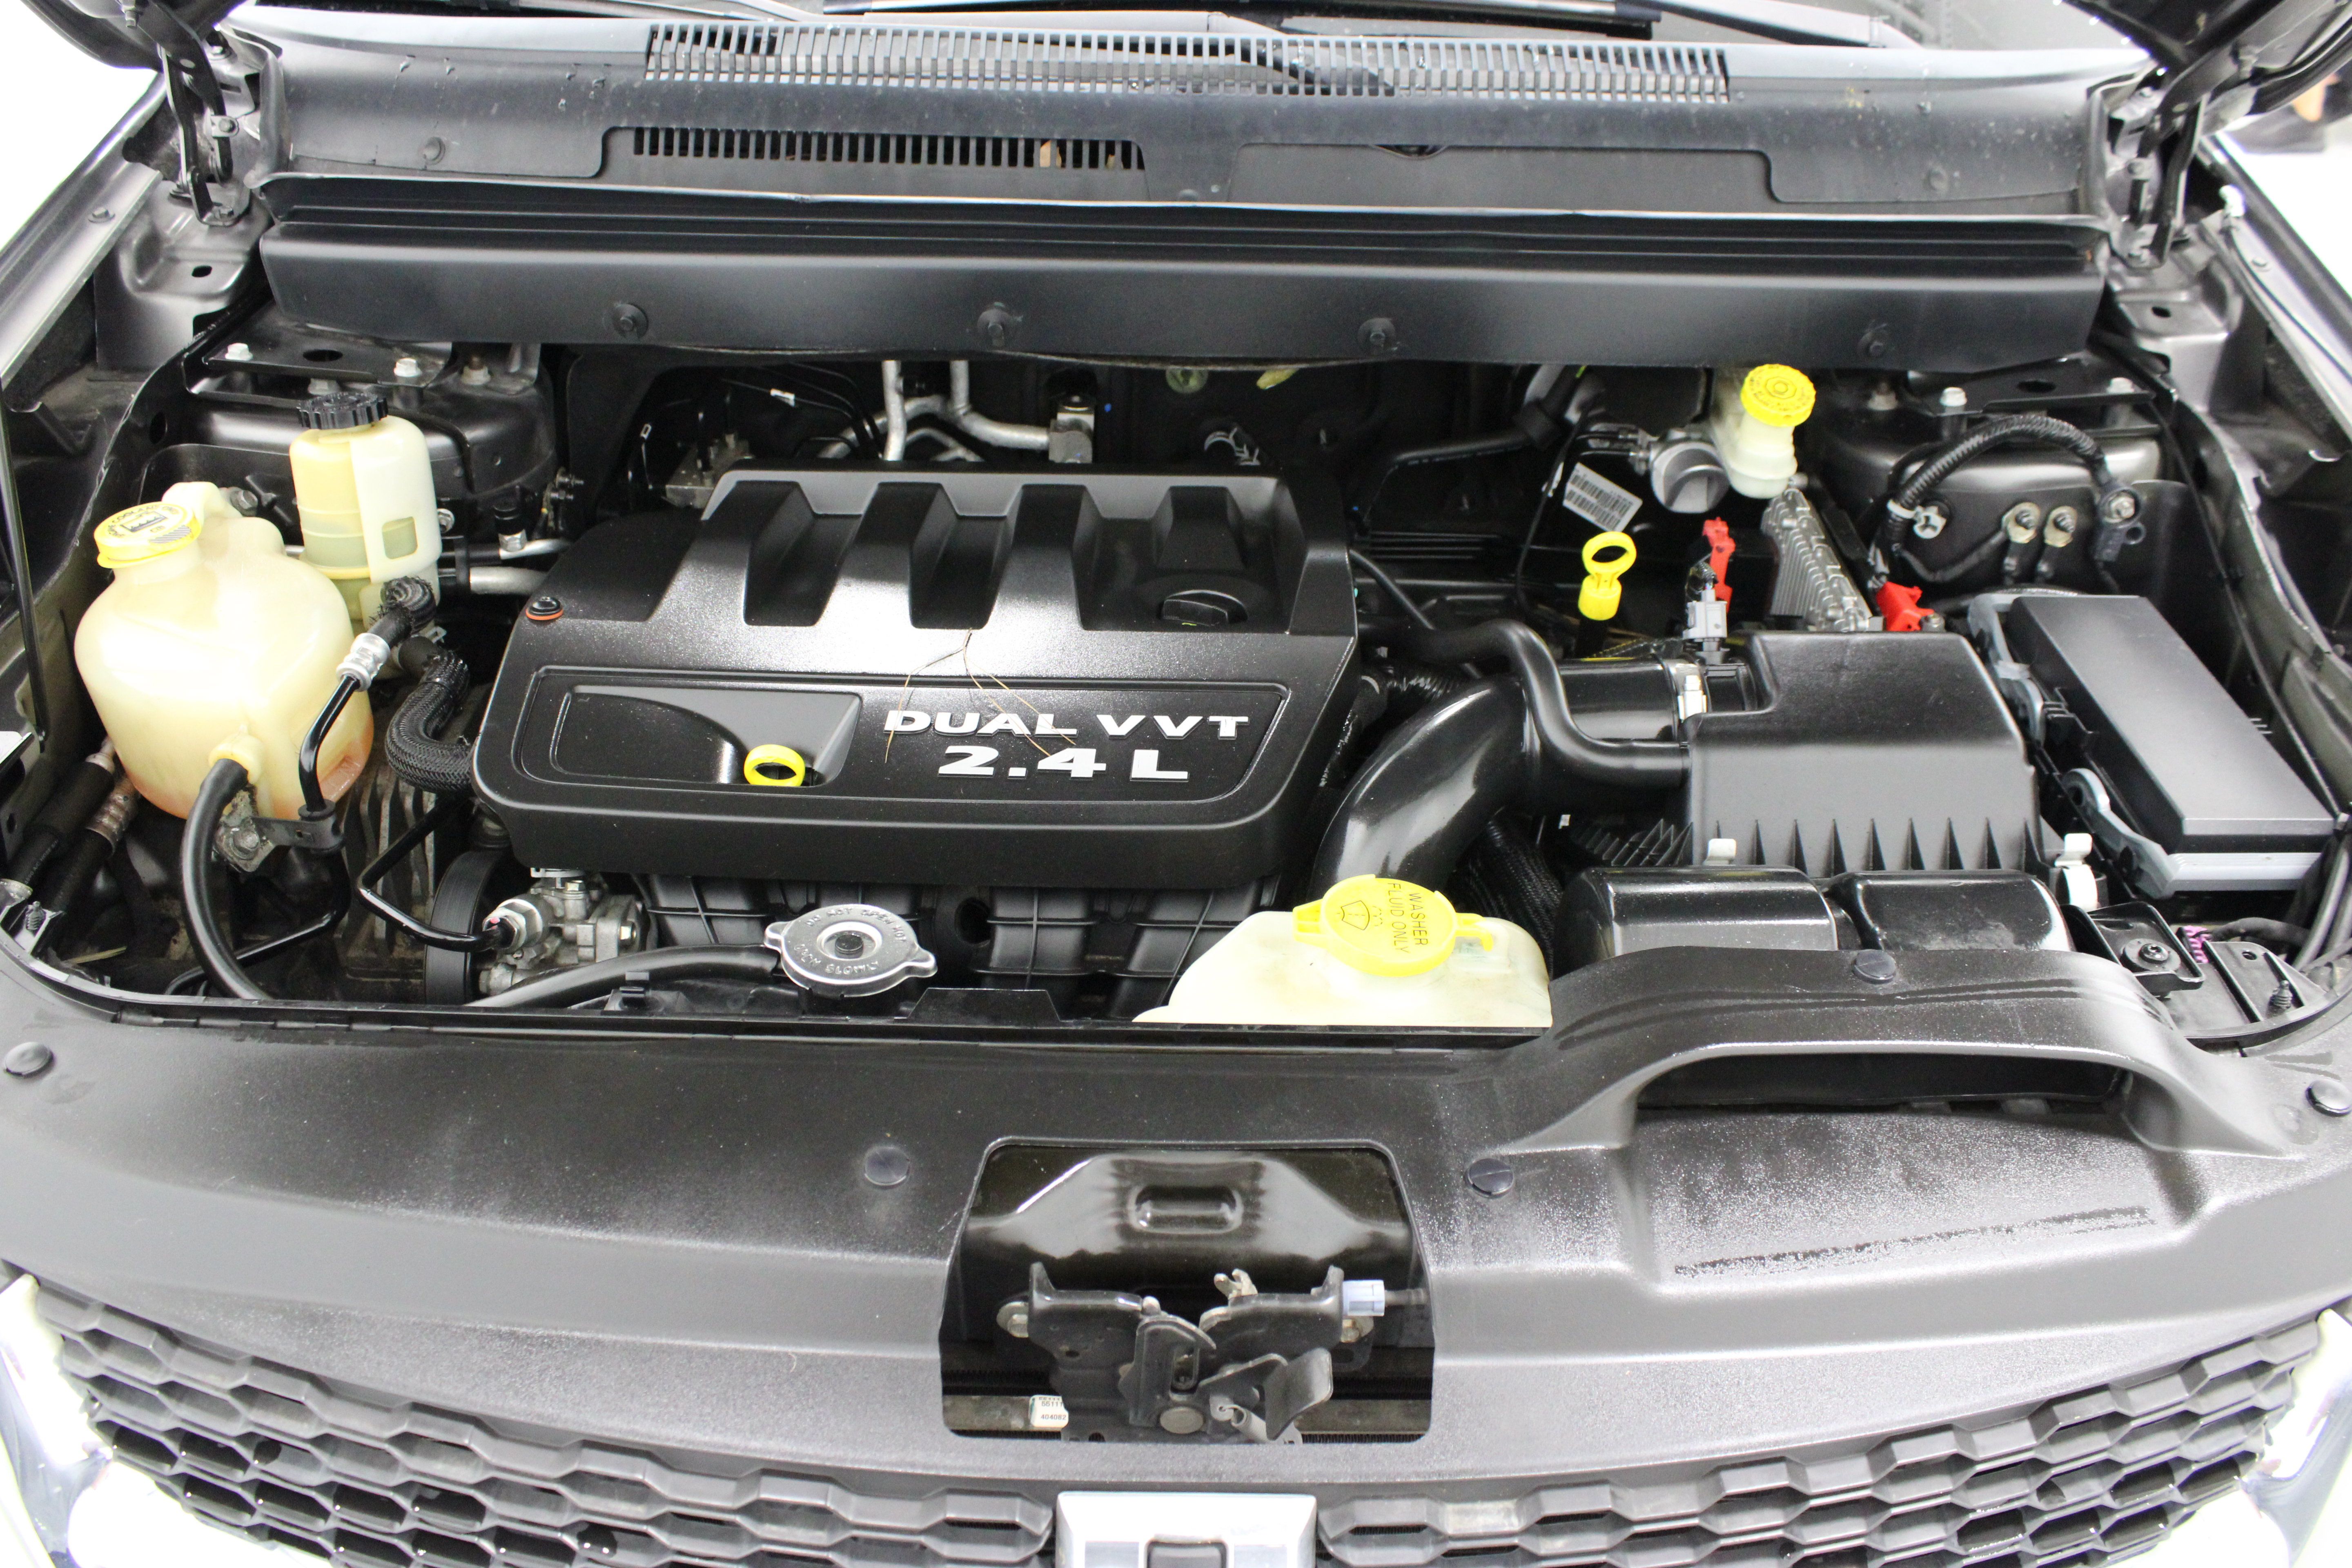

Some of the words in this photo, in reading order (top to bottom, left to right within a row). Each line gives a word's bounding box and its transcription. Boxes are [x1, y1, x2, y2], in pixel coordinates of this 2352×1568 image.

[883, 710, 1078, 737] DUAL
[1096, 714, 1249, 740] VVT
[938, 745, 1107, 780] 2.4
[1129, 749, 1190, 782] L
[1388, 883, 1404, 917] FLUID
[804, 914, 821, 927] DO
[826, 907, 853, 917] NOT
[860, 909, 894, 925] OPEN
[892, 926, 907, 942] HOT
[1408, 892, 1428, 946] WASHER
[1391, 921, 1411, 954] ONLY
[824, 961, 880, 975] SLOWLY
